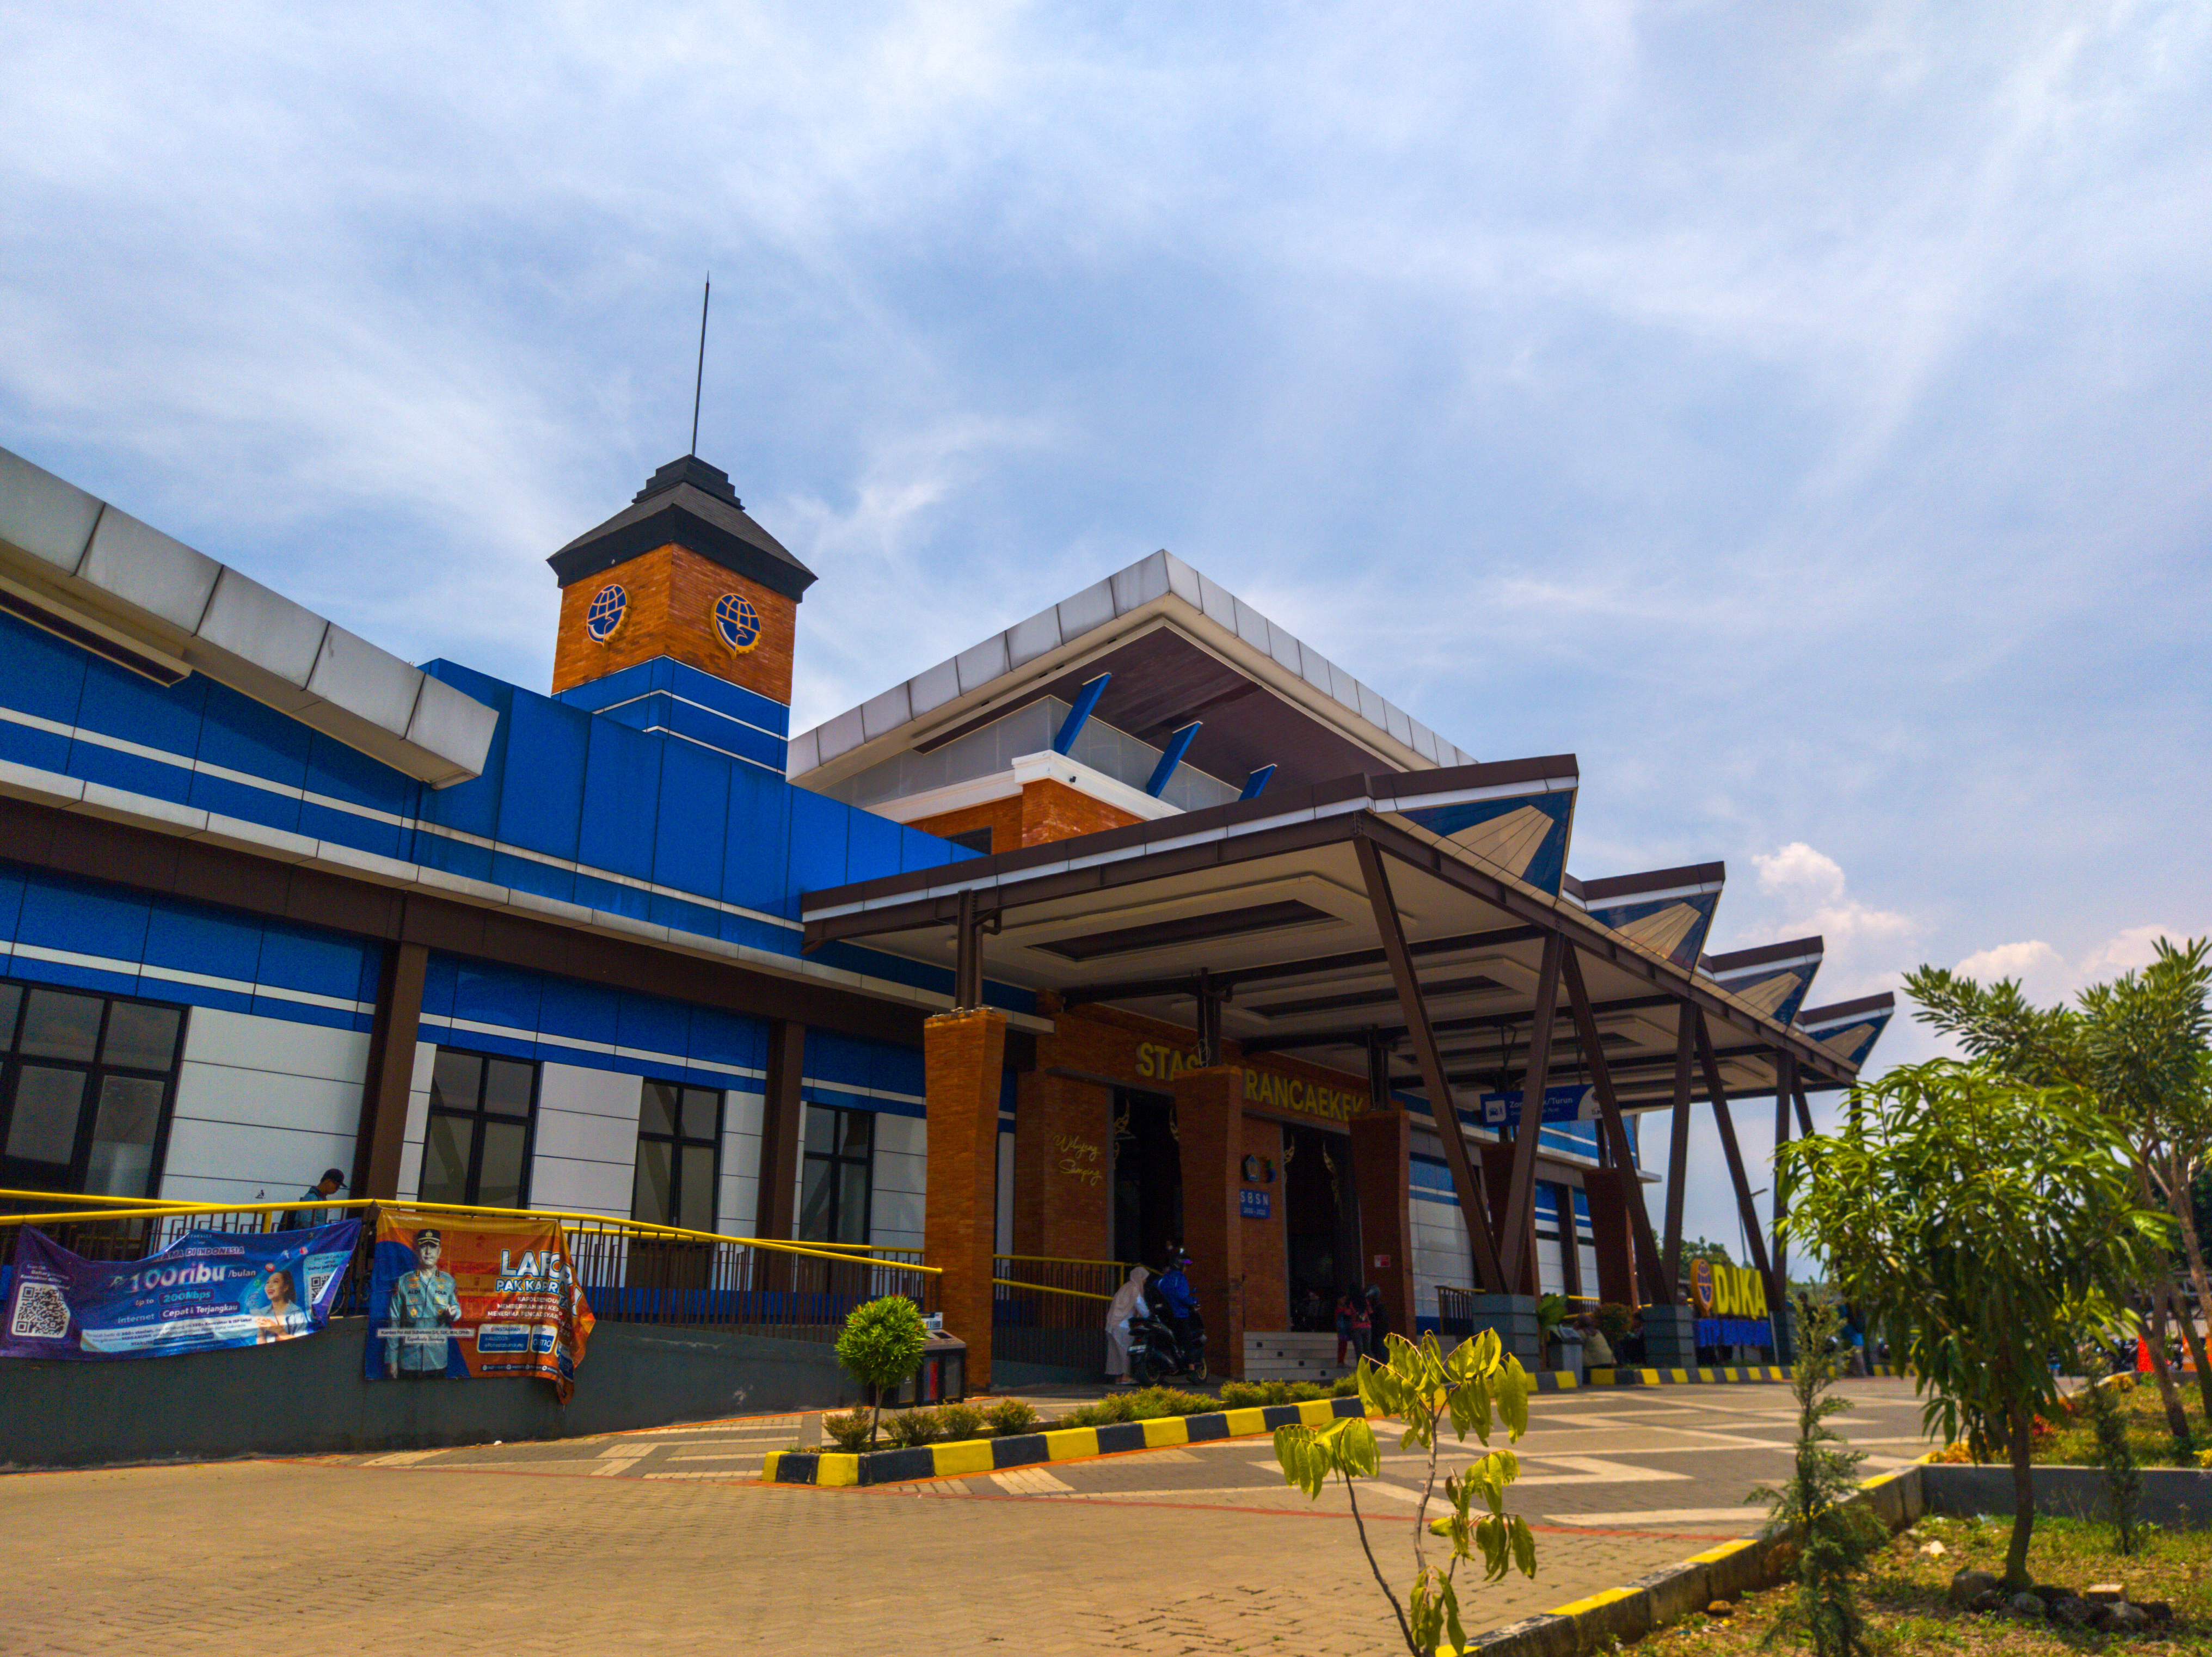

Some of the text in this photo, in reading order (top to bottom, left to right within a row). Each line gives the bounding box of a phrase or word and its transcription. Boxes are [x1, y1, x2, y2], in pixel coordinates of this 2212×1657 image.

[196, 1246, 245, 1256] INDONESIA
[130, 1261, 226, 1293] 100ribu
[228, 1269, 256, 1279] /bulan
[495, 1279, 523, 1292] PAK
[1712, 1263, 1769, 1317] DJKA
[163, 1291, 211, 1303] 200Mbps
[118, 1313, 155, 1324] Internet
[162, 1306, 189, 1318] Cepat
[195, 1304, 238, 1315] Terjangkau
